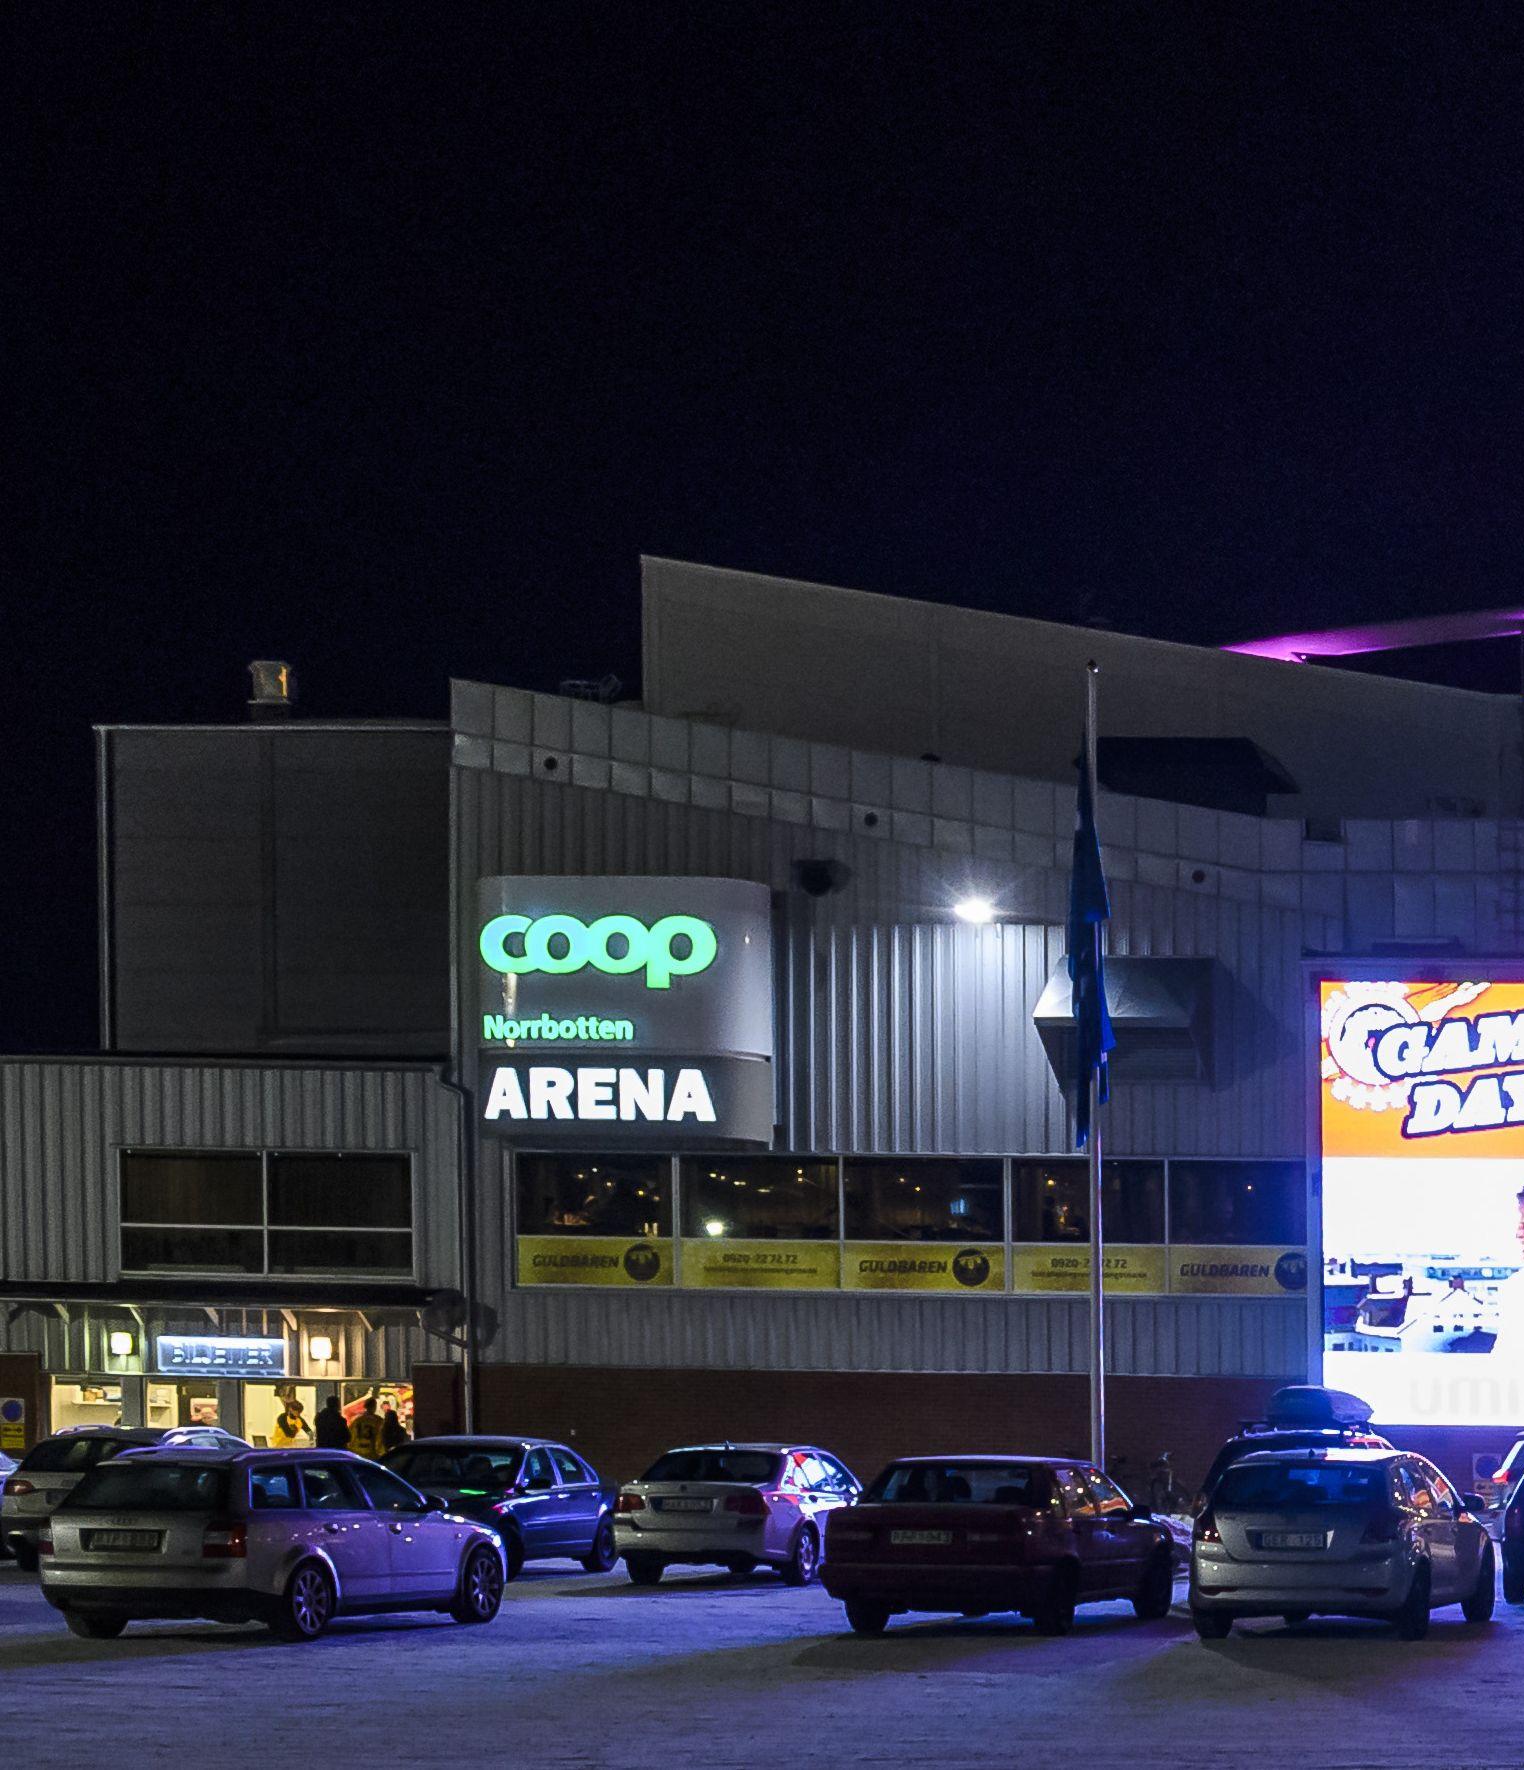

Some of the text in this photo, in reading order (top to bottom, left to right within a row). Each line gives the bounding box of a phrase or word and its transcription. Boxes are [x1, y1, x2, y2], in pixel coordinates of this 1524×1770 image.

[479, 914, 717, 989] coop
[483, 1013, 634, 1040] Norrbotten
[484, 1067, 717, 1122] ARENA
[859, 1259, 948, 1274] GULDBAREN
[1180, 1264, 1270, 1278] GULDBAREN
